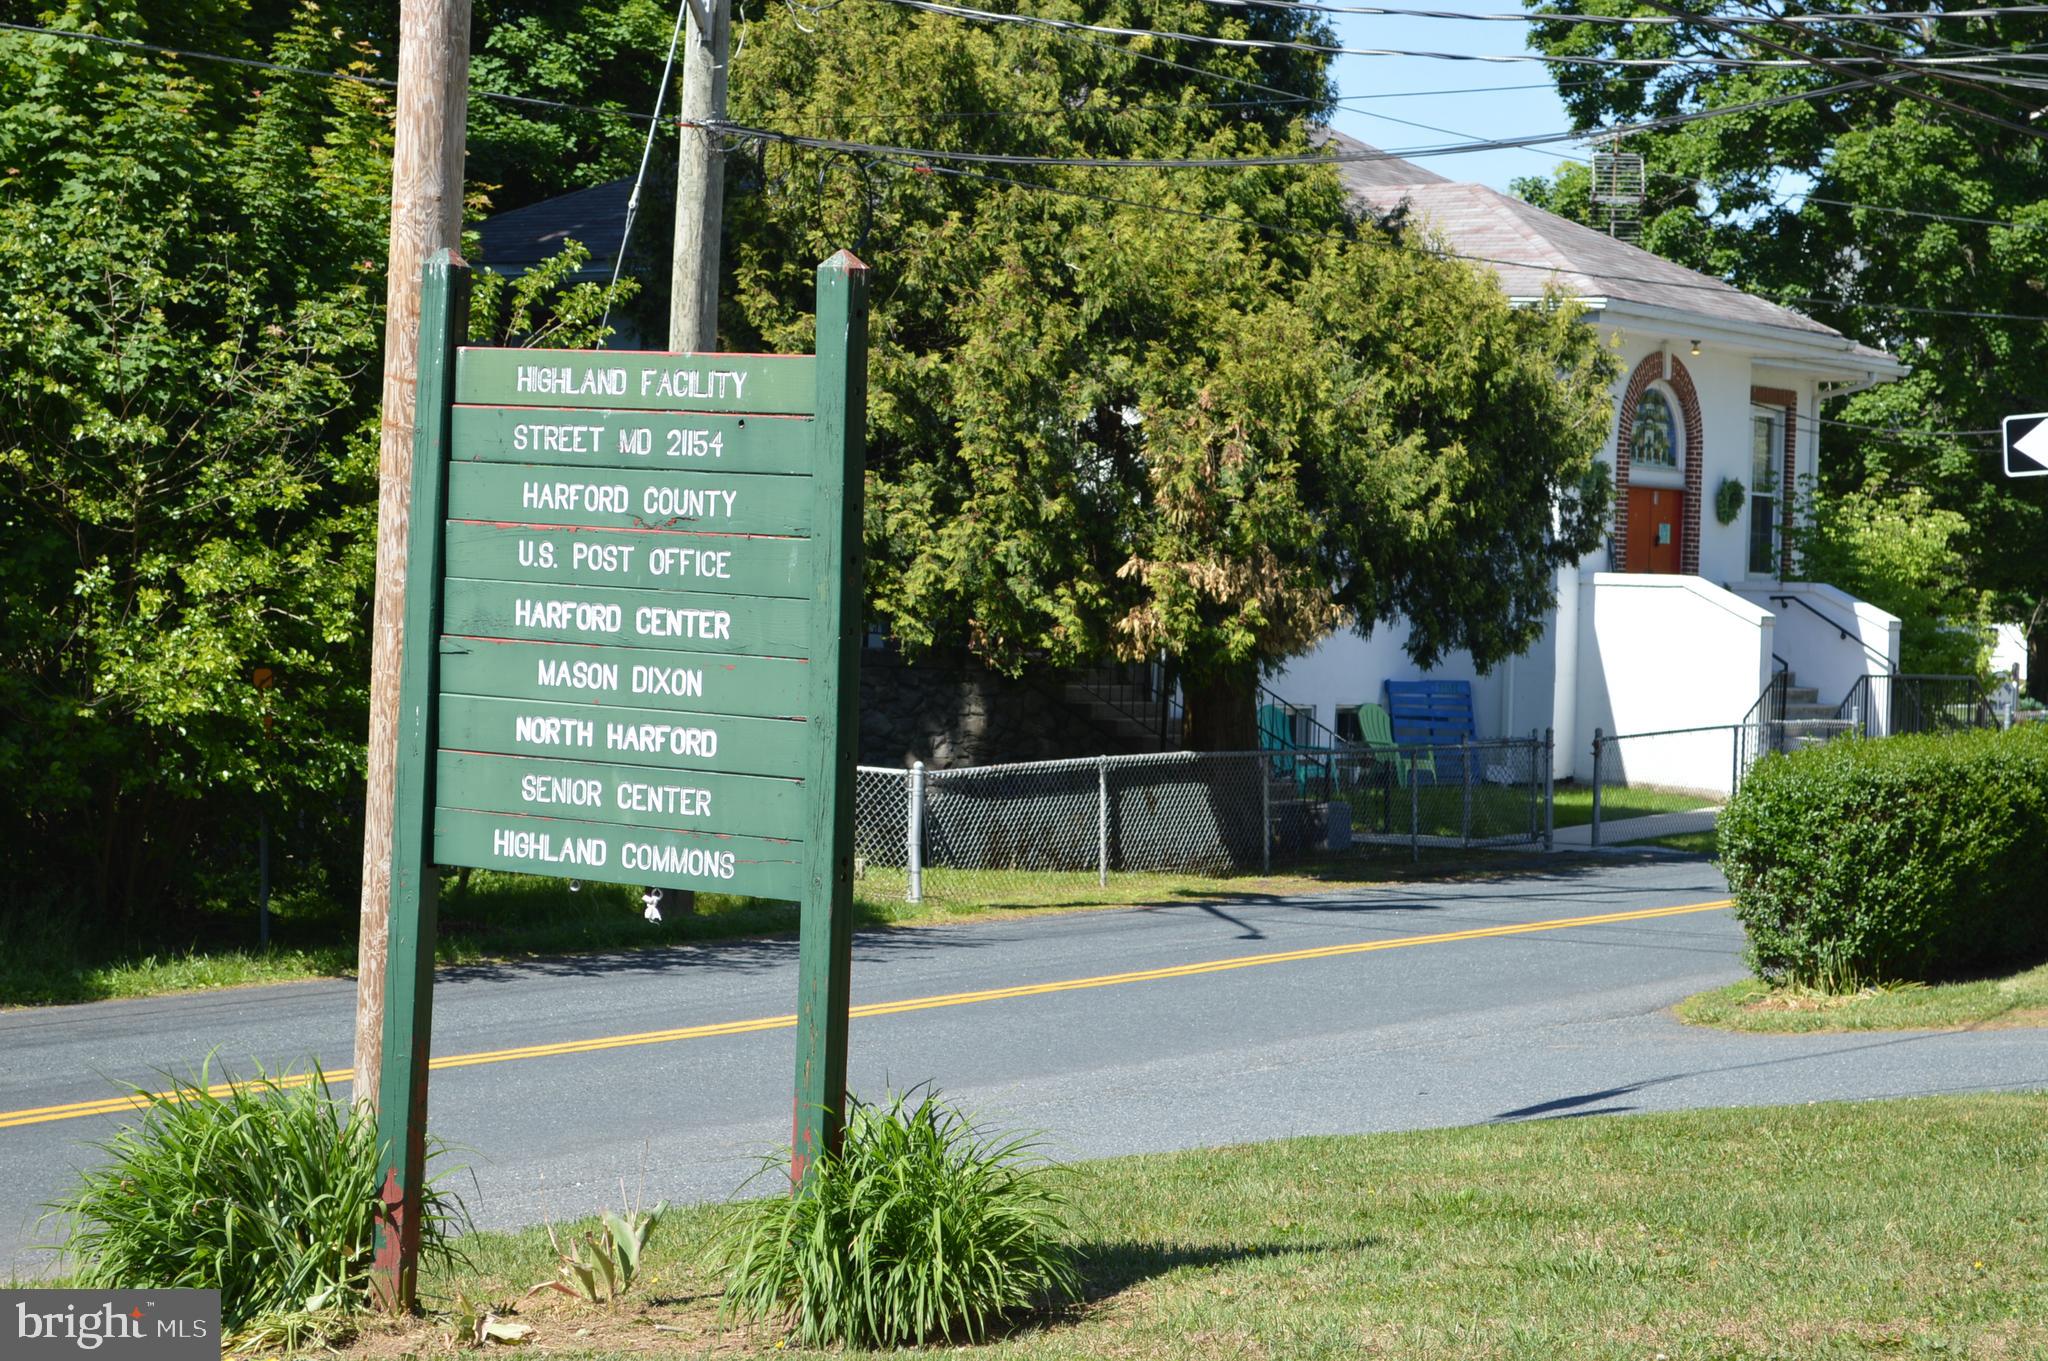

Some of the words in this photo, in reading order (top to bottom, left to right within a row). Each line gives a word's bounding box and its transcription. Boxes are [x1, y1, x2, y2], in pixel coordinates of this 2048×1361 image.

[517, 365, 627, 396] HIGHLAND
[641, 369, 747, 399] FACILITY
[513, 423, 605, 452] STREET
[619, 428, 652, 456] MD
[666, 429, 724, 458] 21154
[522, 481, 629, 514] HARFORD
[643, 486, 737, 518] COUNTY
[518, 539, 558, 569] U.S.
[573, 542, 635, 572] POST
[648, 547, 731, 579] OFFICE
[515, 598, 622, 633] HARFORD
[636, 606, 731, 640] CENTER
[537, 659, 618, 691] MASON
[632, 665, 703, 697] DIXON
[515, 715, 593, 747] NORTH
[606, 722, 718, 758] HARFORD
[521, 773, 602, 808] SENIOR
[616, 781, 712, 817] CENTER
[493, 828, 607, 867] HIGHLAND
[621, 841, 736, 880] COMMONS
